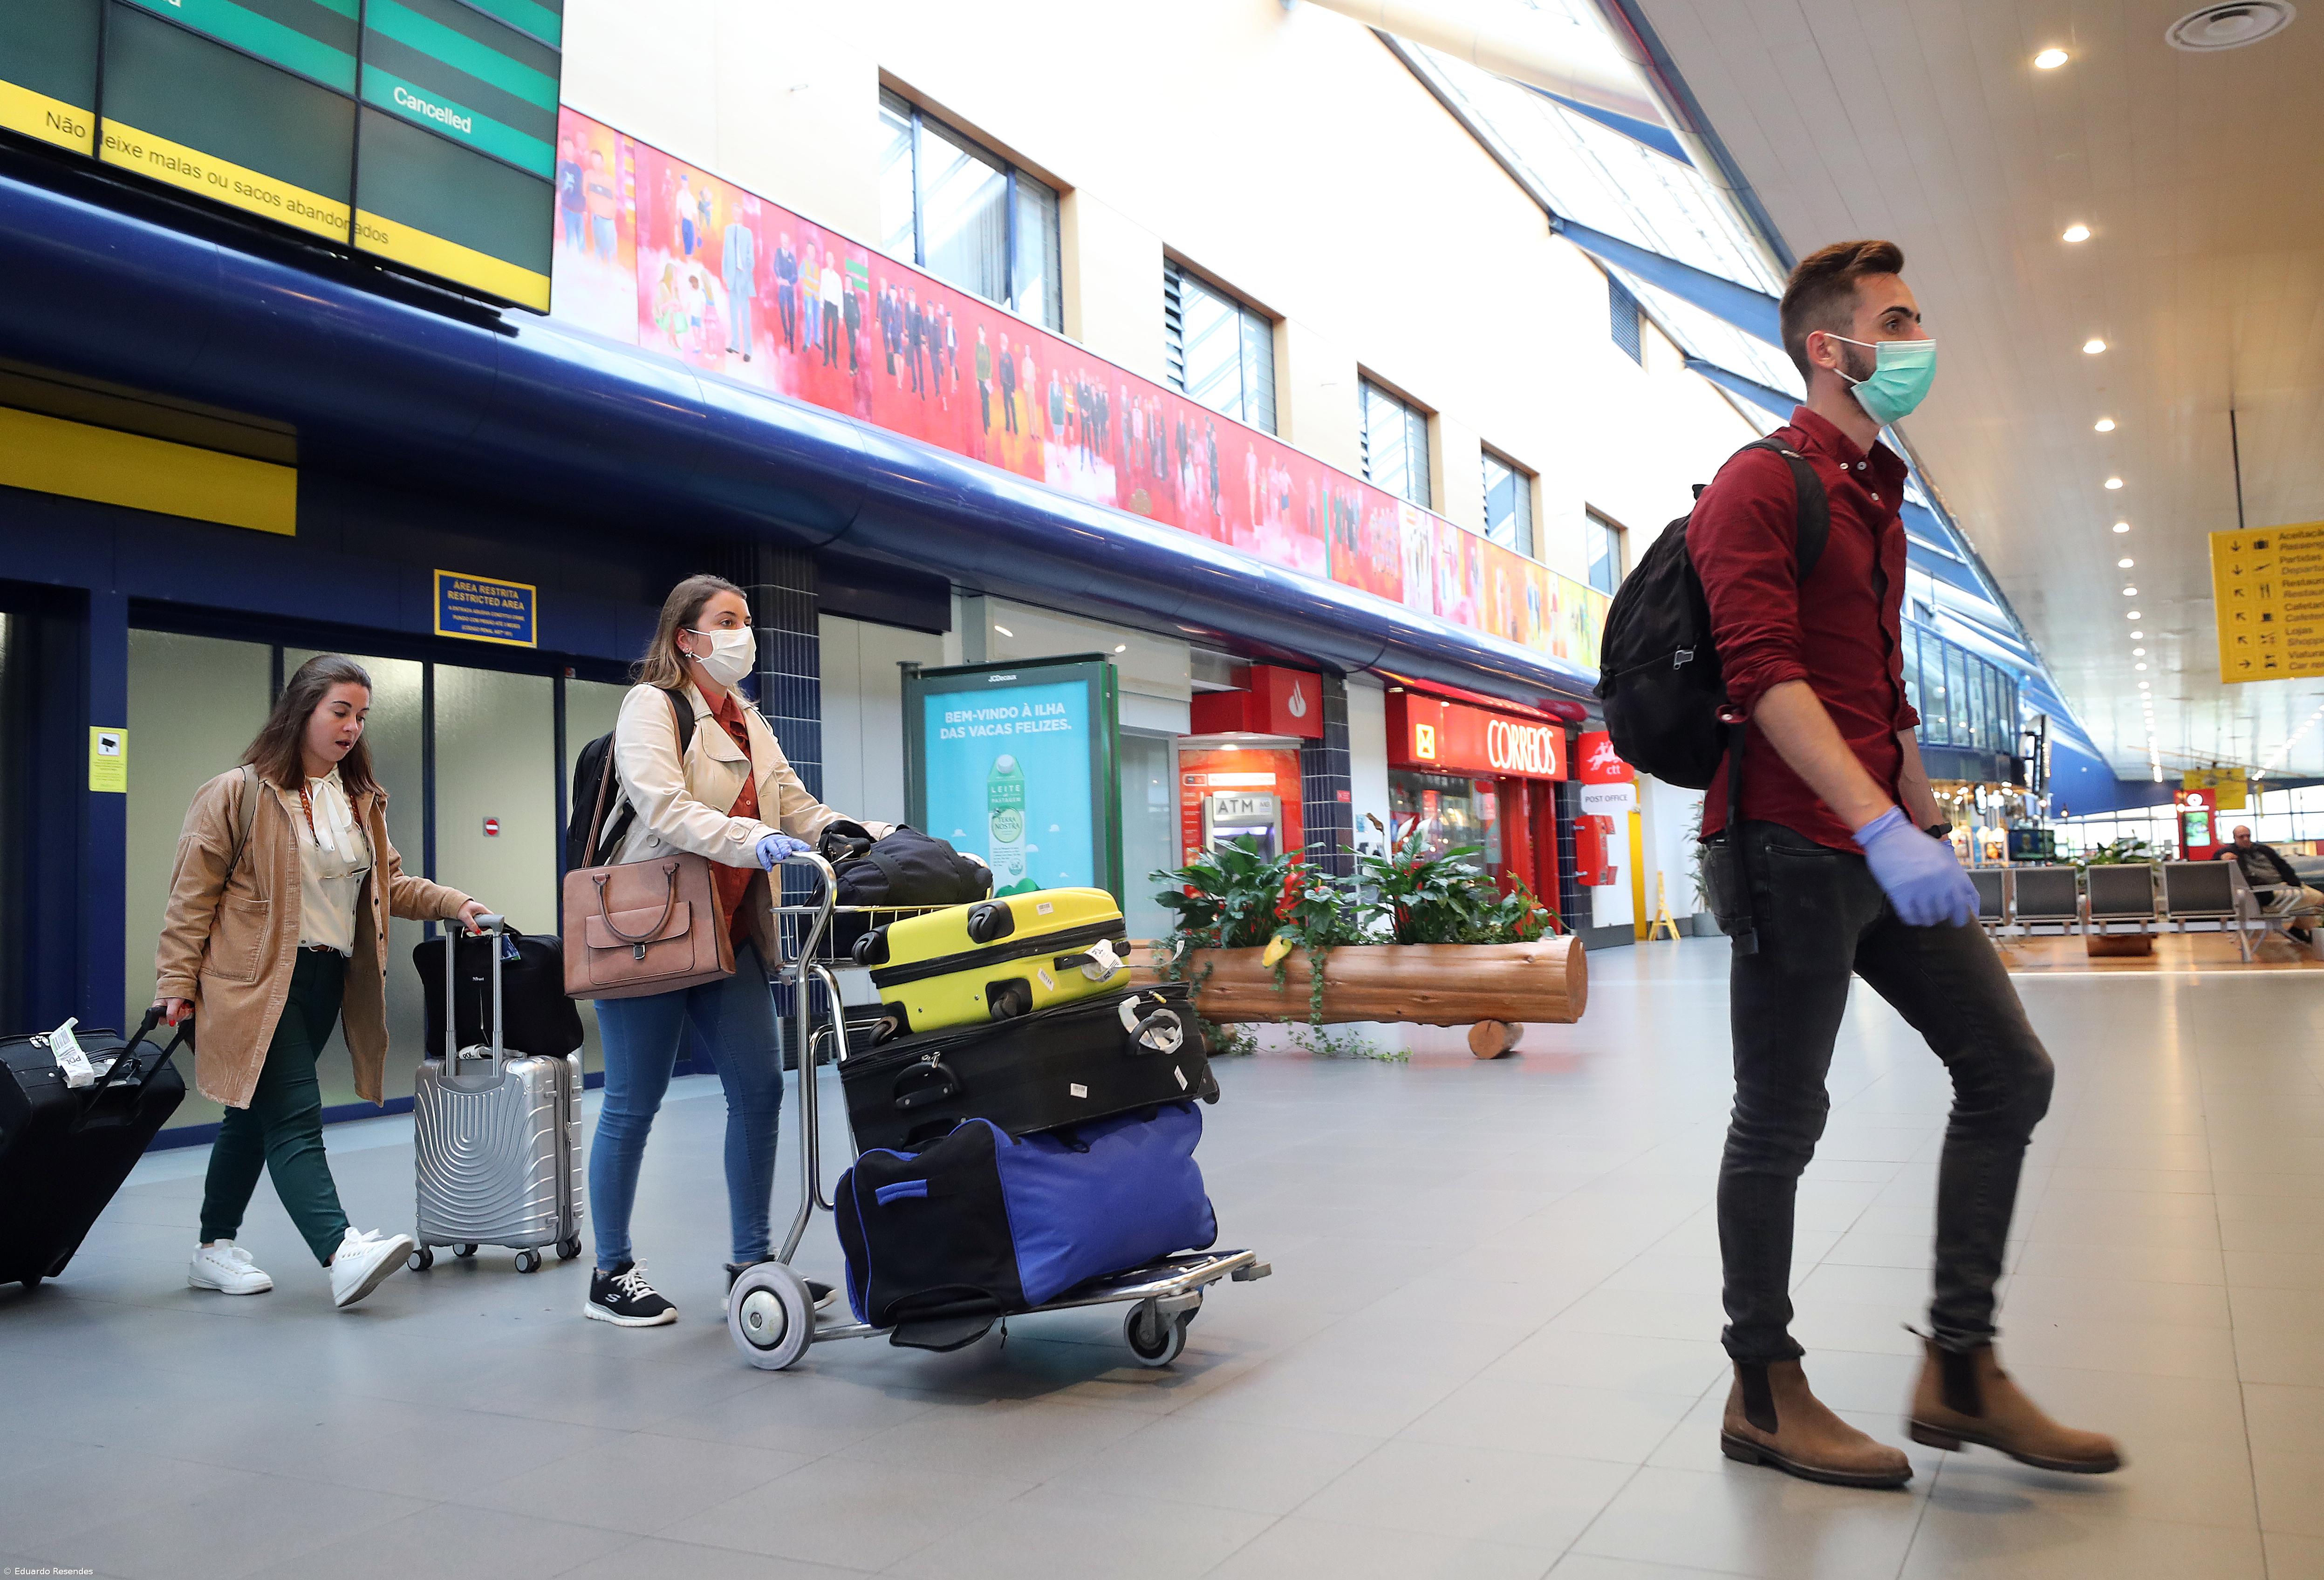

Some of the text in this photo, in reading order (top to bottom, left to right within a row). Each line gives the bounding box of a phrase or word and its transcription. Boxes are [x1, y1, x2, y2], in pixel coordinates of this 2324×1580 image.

[394, 87, 472, 134] Cancelled
[46, 110, 86, 138] Não
[101, 129, 143, 158] eixe
[149, 150, 202, 179] malas
[208, 172, 228, 188] ou
[234, 180, 281, 206] sacos
[453, 579, 519, 599] ÁREA RESTRITA
[447, 590, 525, 610] RESTRICTED AREA
[945, 702, 1066, 723] BEM-VINDO À ILHA
[940, 718, 1072, 739] DAS VACAS FELIZES.
[1488, 720, 1556, 775] CORREIOS
[1606, 765, 1621, 775] ctt
[1217, 799, 1253, 813] ATM
